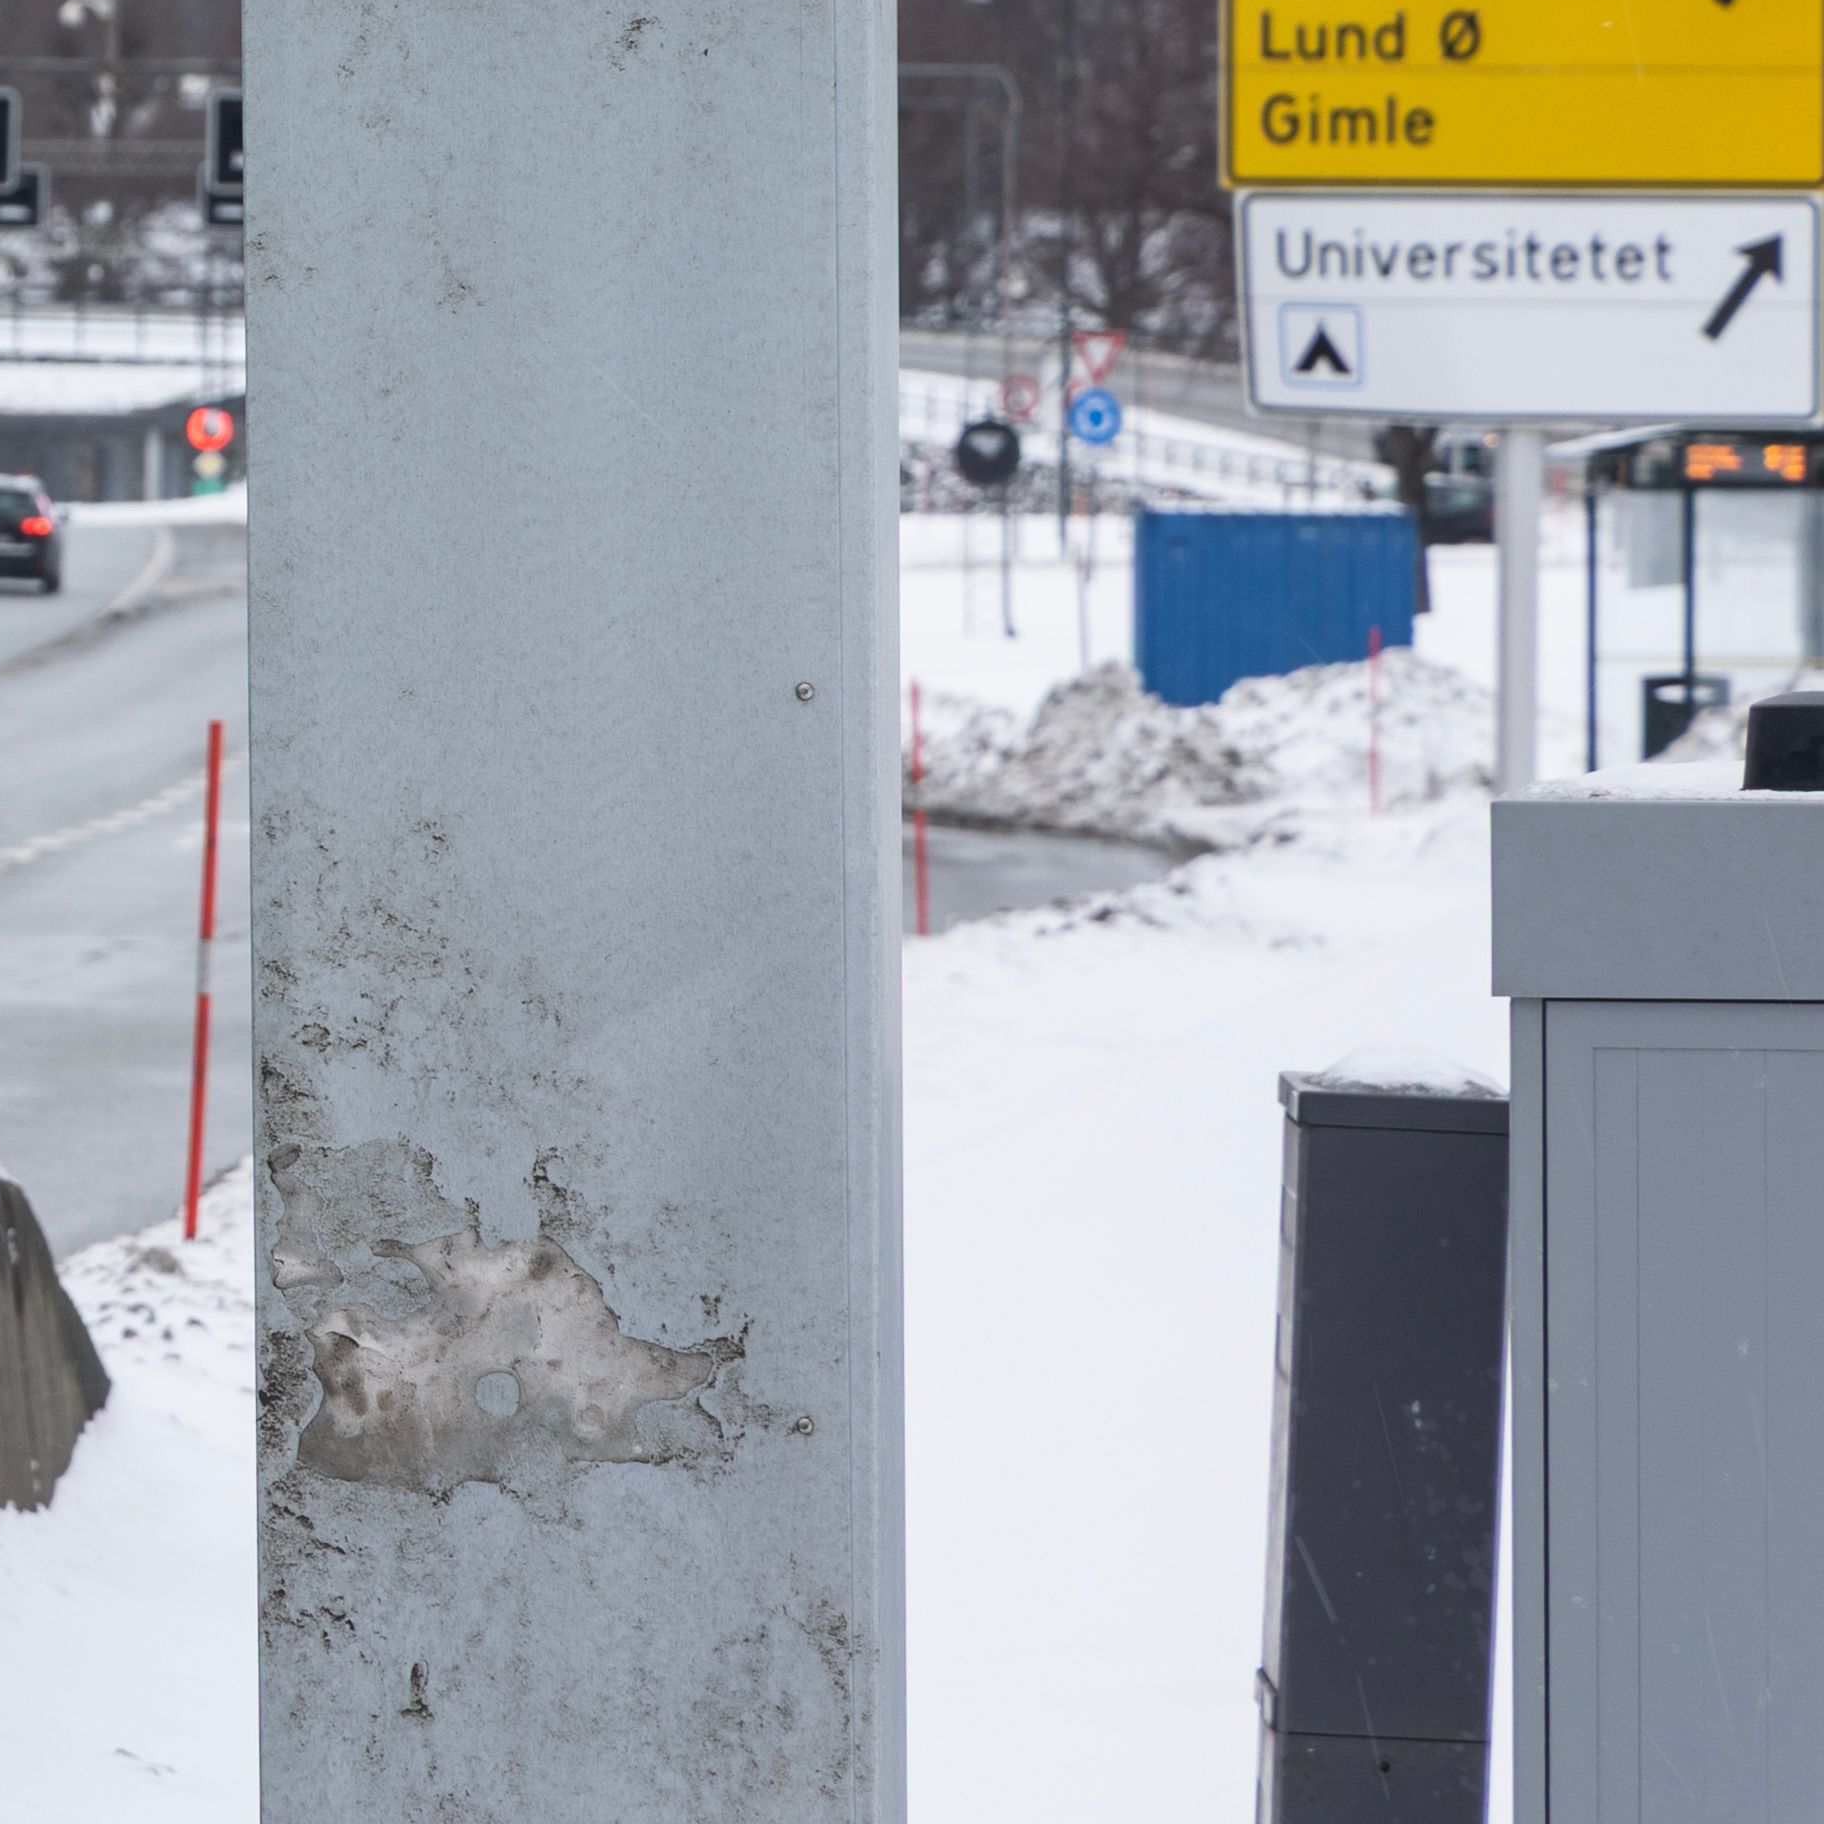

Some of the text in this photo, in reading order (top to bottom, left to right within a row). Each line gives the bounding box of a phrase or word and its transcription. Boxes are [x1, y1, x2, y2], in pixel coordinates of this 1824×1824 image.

[1260, 10, 1483, 63] Lund Ø
[1260, 93, 1437, 146] Gimle
[1276, 229, 1674, 282] Universitetet
